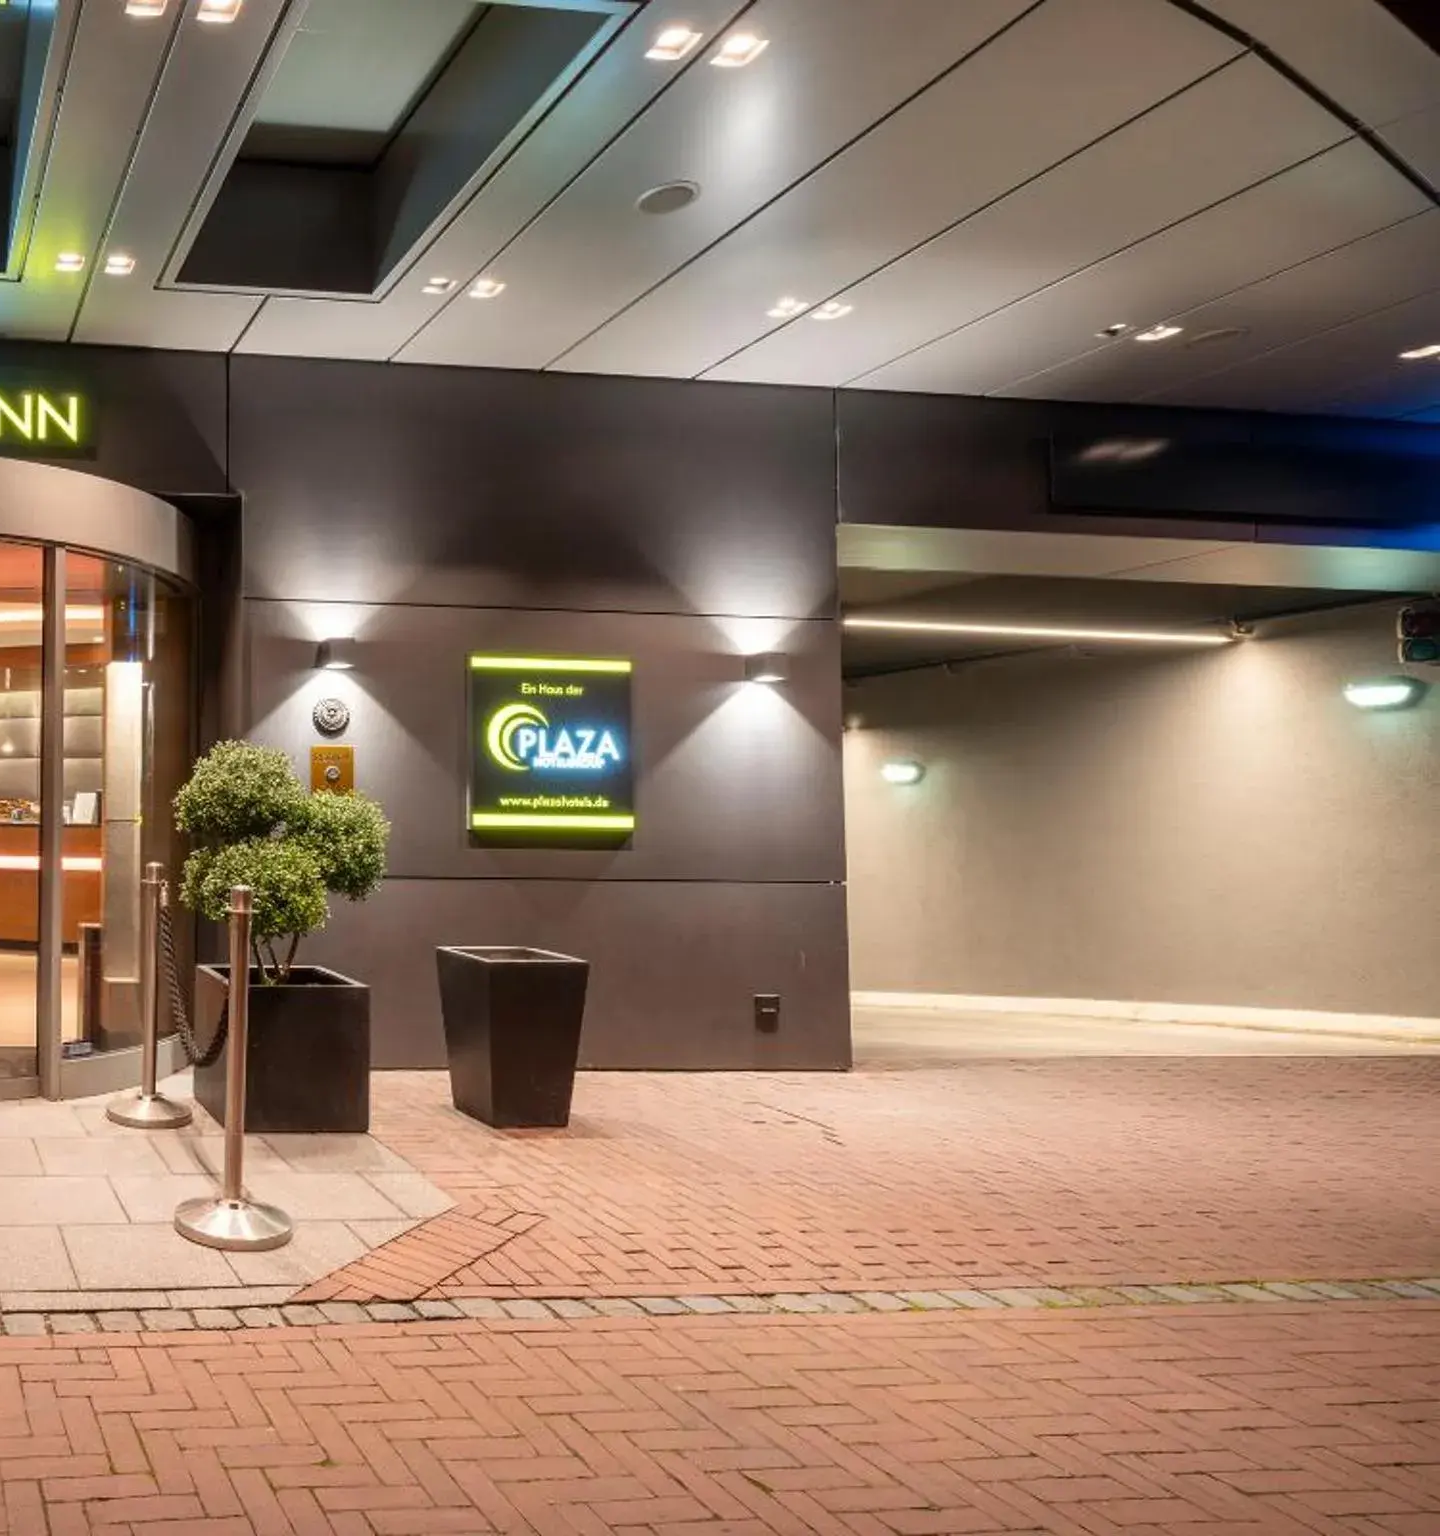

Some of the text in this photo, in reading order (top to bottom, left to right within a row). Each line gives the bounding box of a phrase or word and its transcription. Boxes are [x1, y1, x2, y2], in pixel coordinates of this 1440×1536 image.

[521, 682, 585, 696] Ein Haus der
[518, 728, 621, 761] PLAZA
